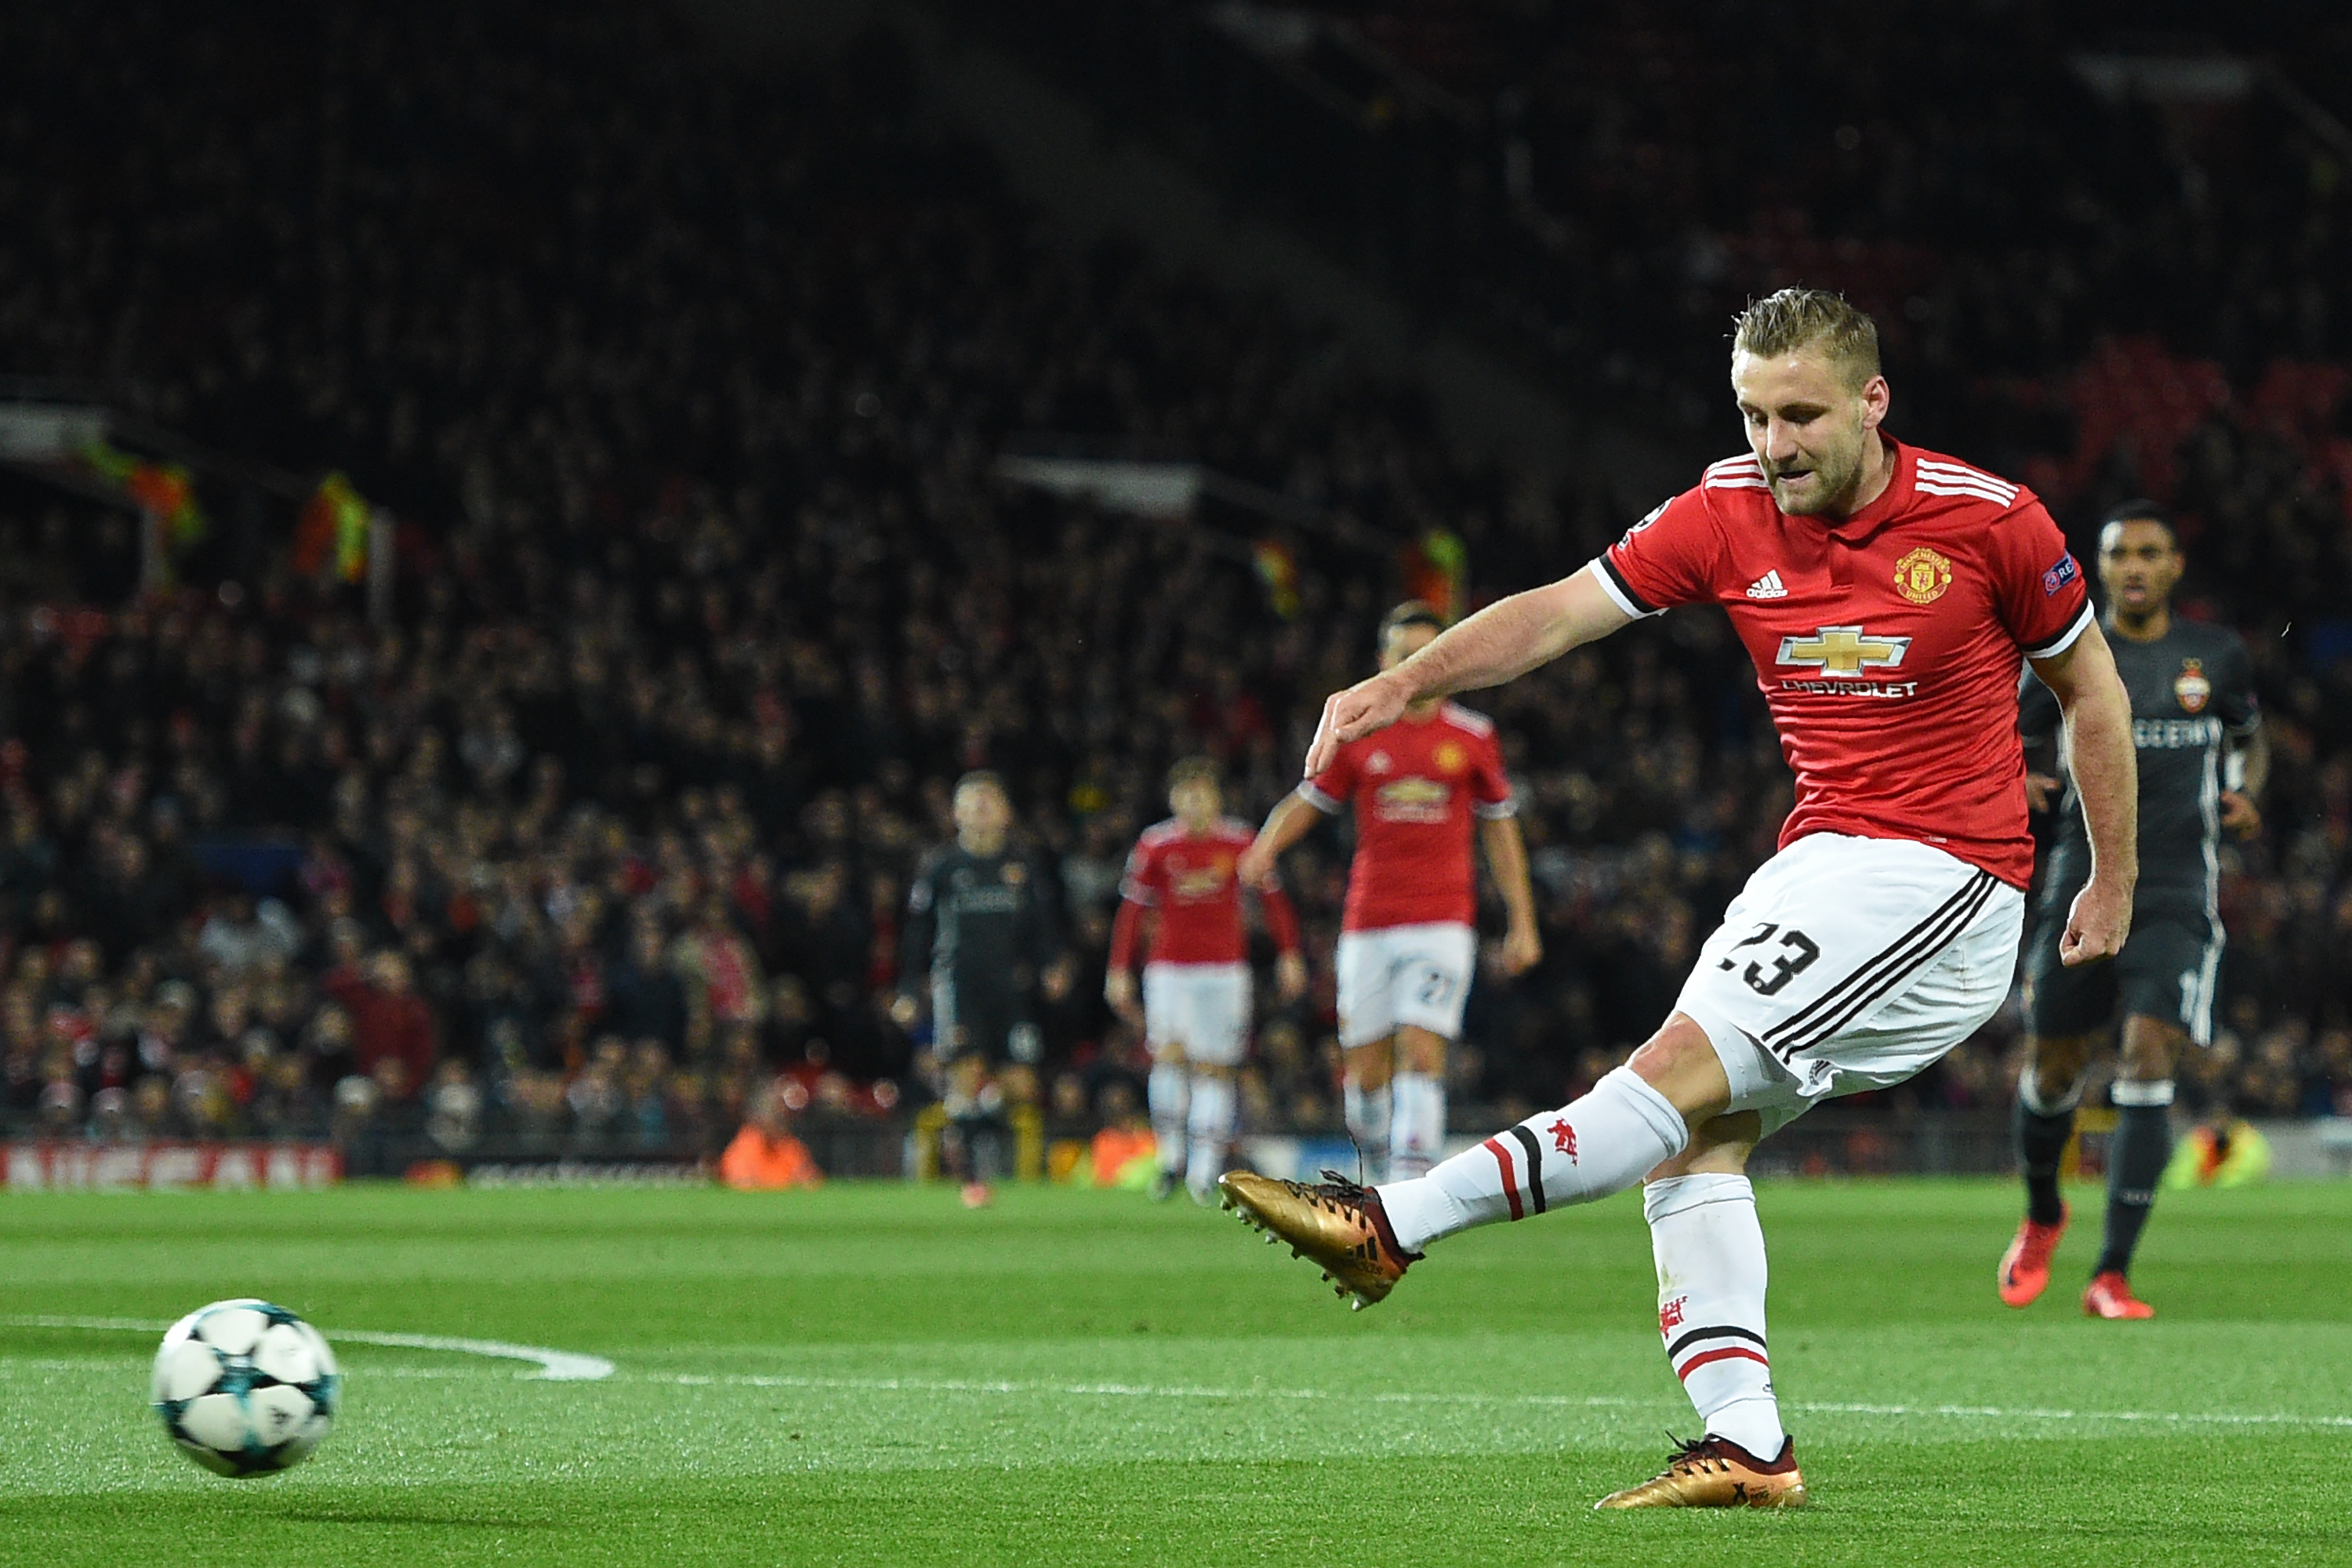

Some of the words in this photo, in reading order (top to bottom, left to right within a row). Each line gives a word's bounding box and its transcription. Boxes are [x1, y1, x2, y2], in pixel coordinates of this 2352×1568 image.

[1746, 588, 1788, 599] adidas
[1905, 590, 1938, 600] UNITED
[1781, 680, 1918, 698] CHEVROLET
[1715, 921, 1820, 996] 23
